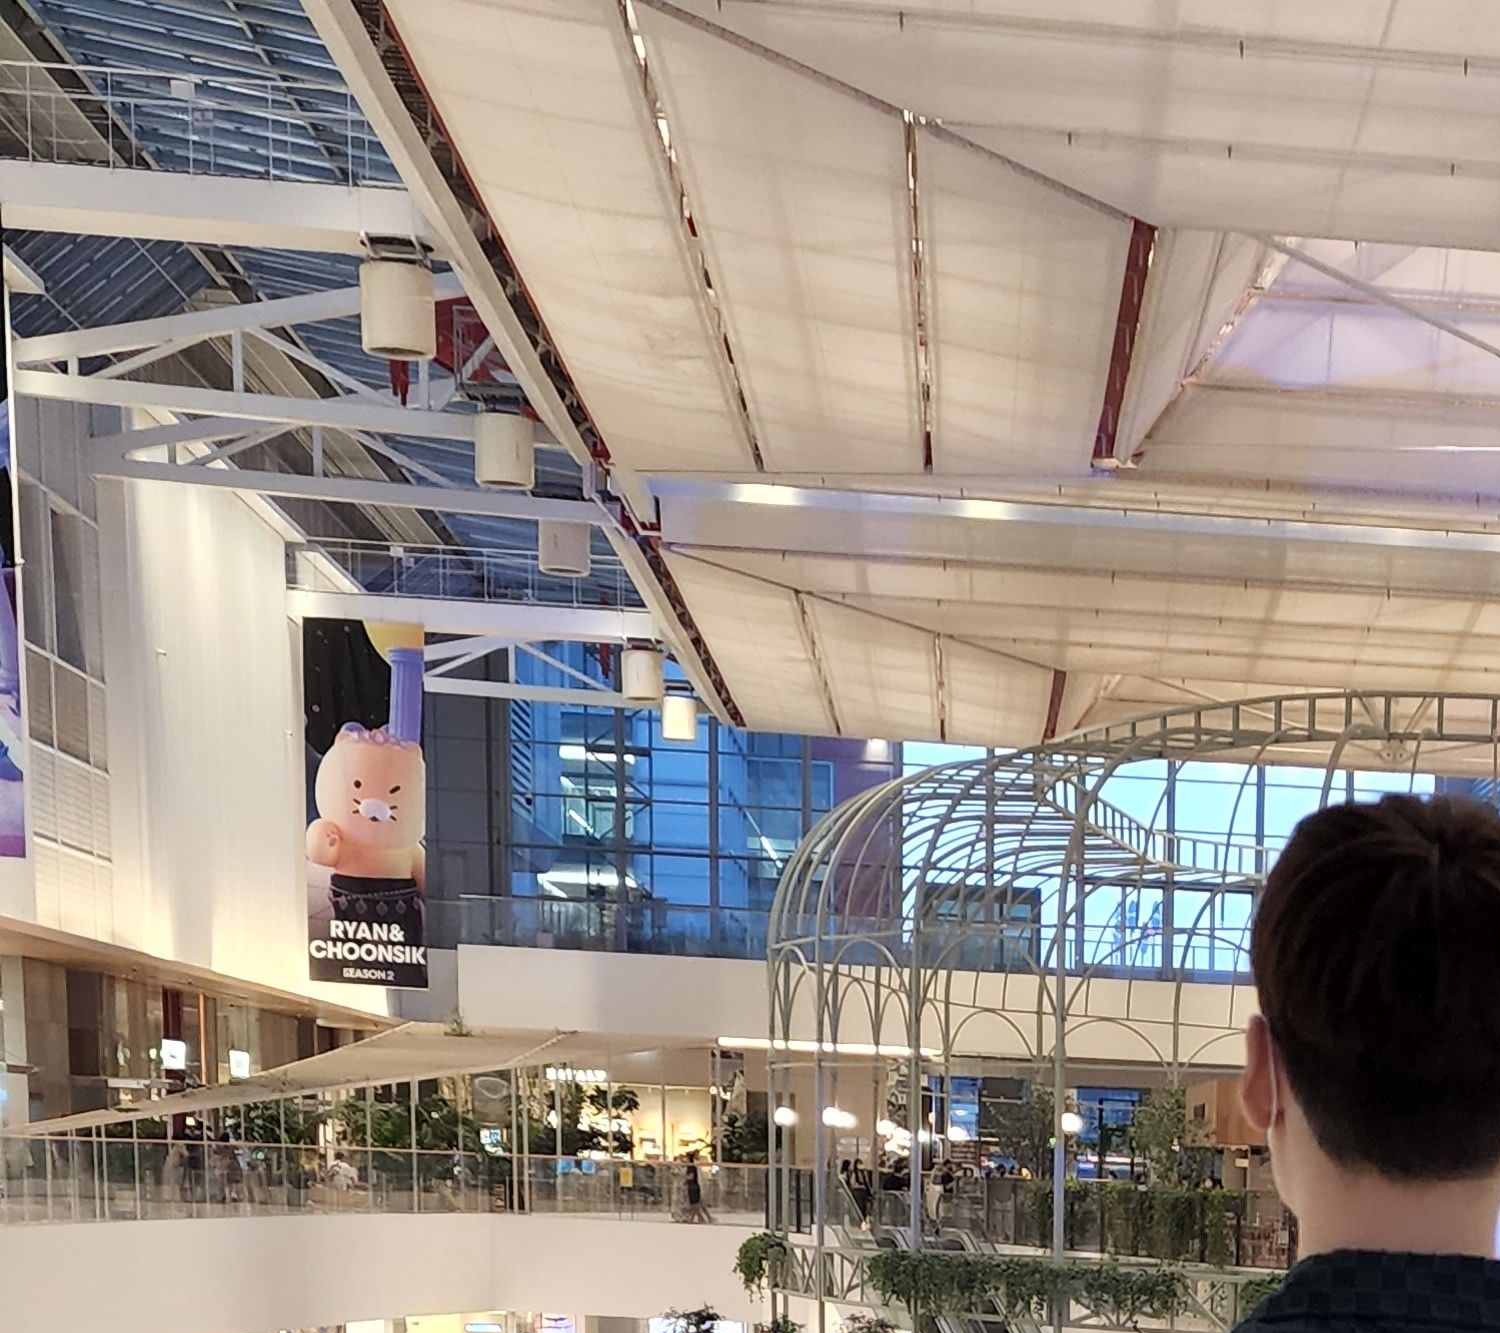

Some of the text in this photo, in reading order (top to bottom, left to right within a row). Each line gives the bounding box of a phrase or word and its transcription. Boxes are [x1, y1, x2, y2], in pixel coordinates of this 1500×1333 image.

[330, 919, 405, 942] RYAN&
[309, 939, 427, 965] CHOONSIK
[342, 967, 395, 980] SEASON 2
